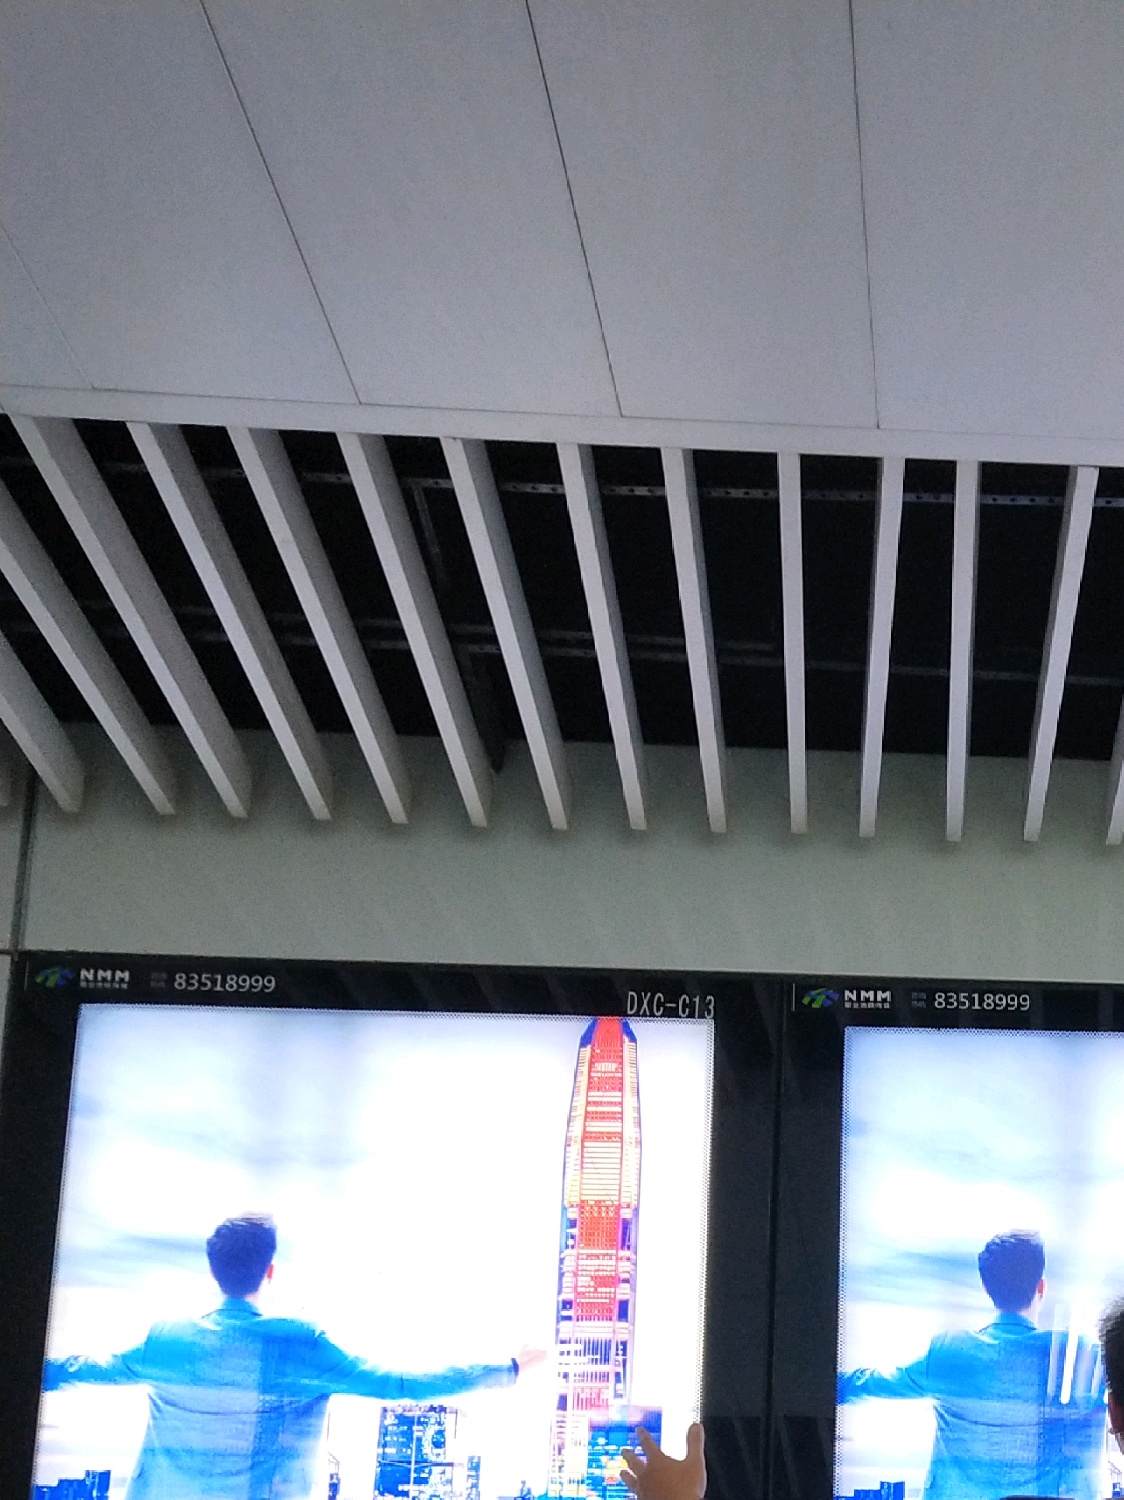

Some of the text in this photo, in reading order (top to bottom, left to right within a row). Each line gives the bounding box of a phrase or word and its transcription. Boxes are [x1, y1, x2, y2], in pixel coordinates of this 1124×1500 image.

[79, 968, 130, 982] NMM
[173, 973, 276, 993] 83518999
[626, 991, 715, 1019] DXC-C13
[844, 990, 892, 1002] NMM
[934, 992, 1030, 1011] 83518999
